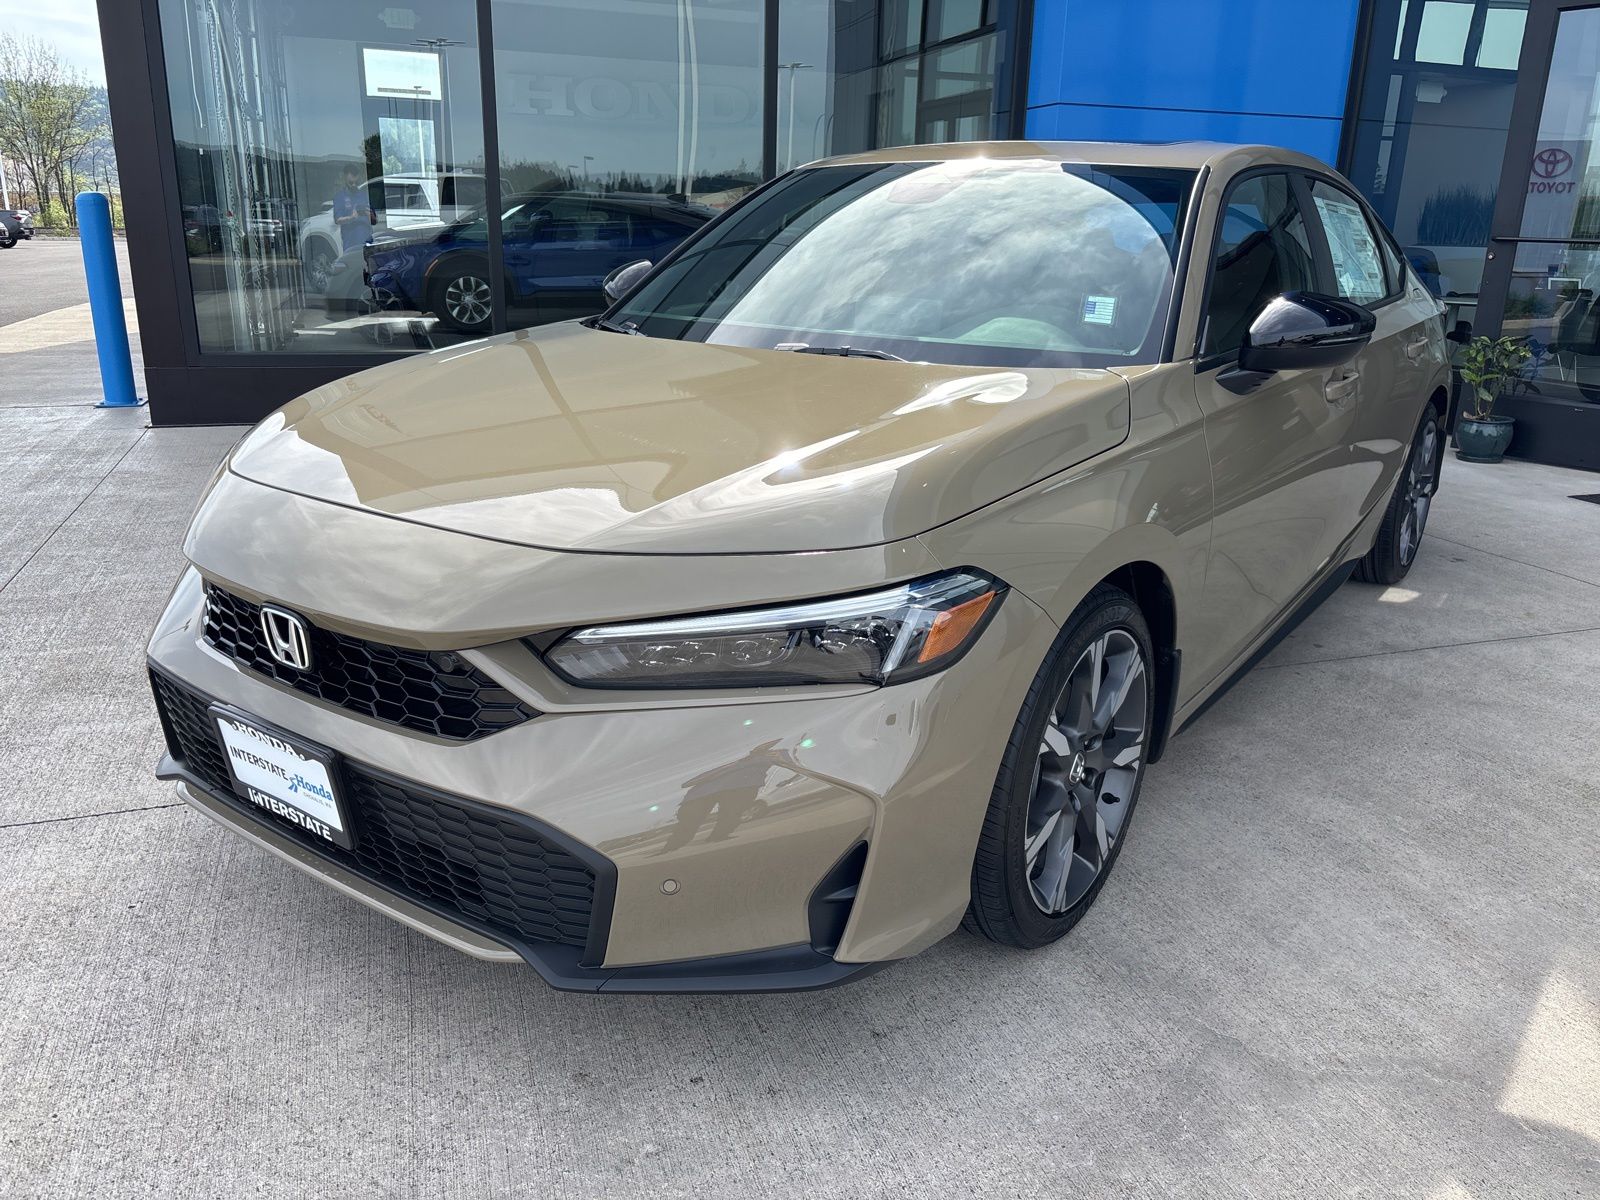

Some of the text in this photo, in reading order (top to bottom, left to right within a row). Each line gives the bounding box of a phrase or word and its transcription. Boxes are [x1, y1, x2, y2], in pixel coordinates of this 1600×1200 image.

[504, 70, 763, 127] HOND
[1530, 181, 1576, 194] TOYOT
[234, 721, 297, 756] HONDA
[230, 745, 289, 781] INTERSTATE
[293, 773, 333, 801] Honda
[248, 787, 333, 841] INTERSTATE
